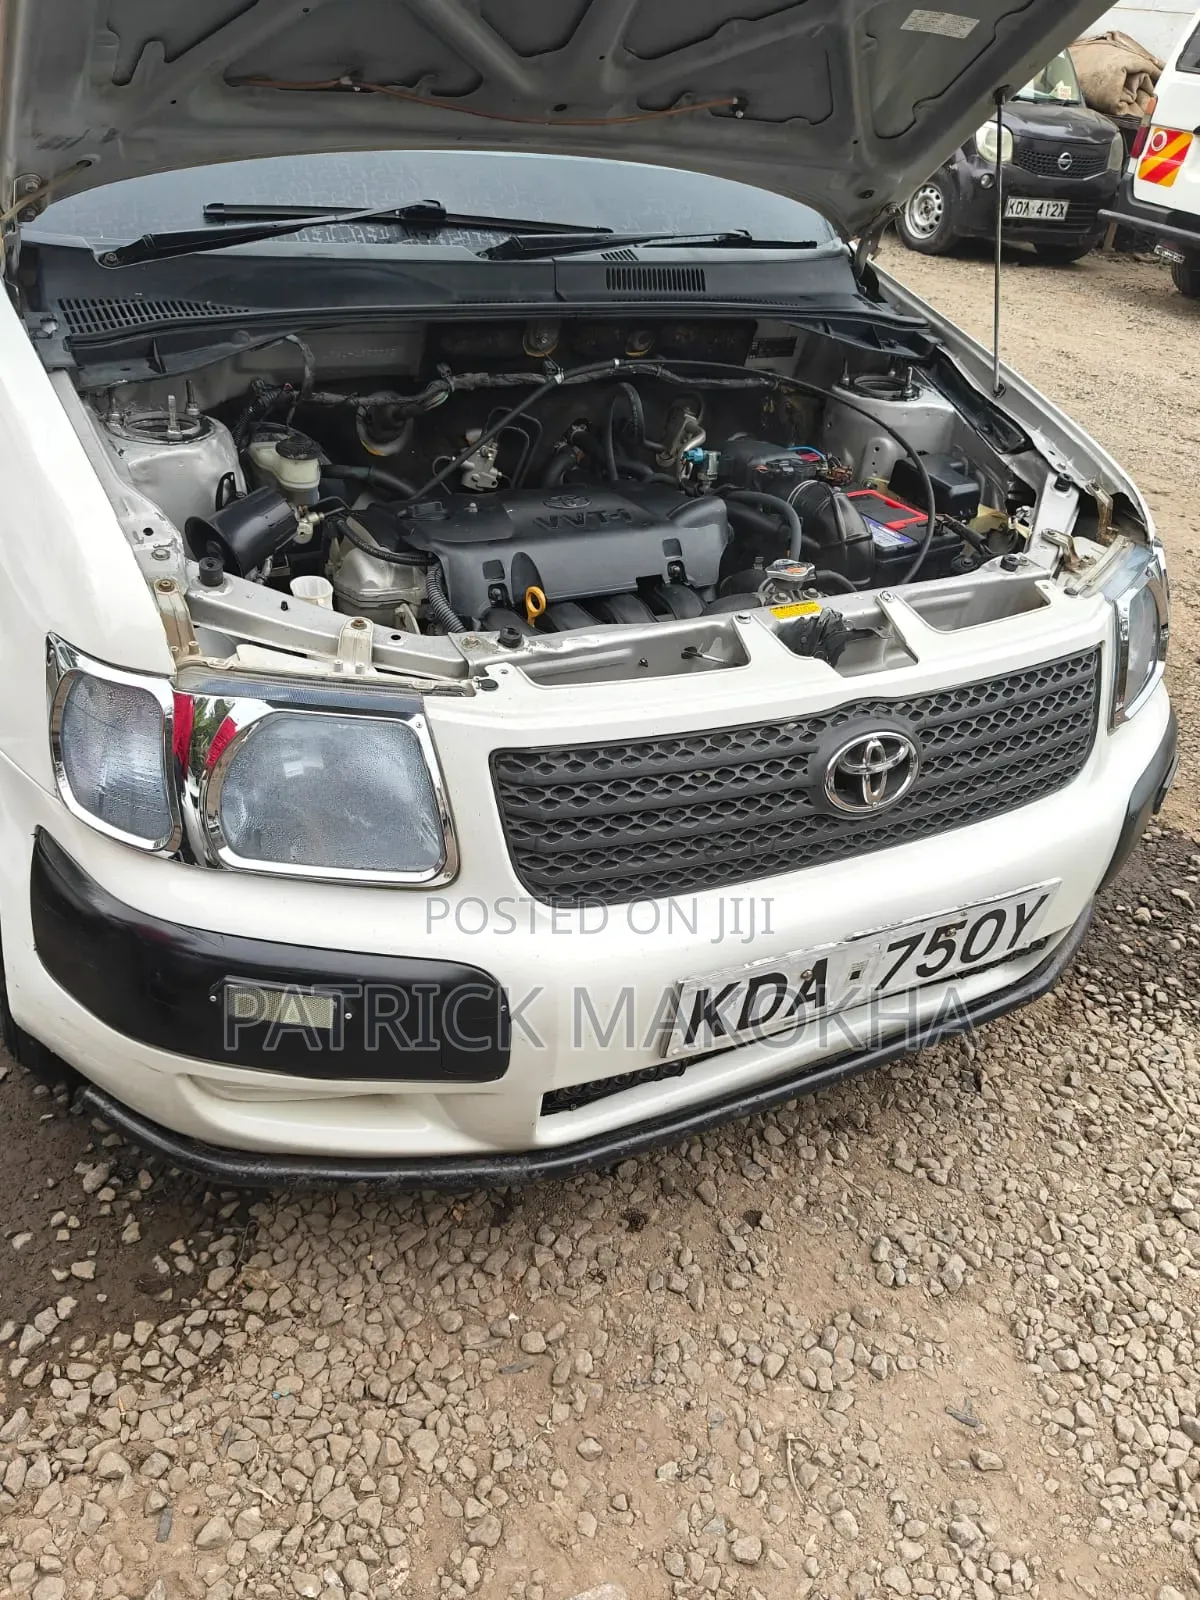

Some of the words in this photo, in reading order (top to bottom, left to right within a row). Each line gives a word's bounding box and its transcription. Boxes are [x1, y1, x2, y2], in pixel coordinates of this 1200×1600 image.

[1035, 202, 1065, 217] 412X
[684, 957, 829, 1046] KDA
[875, 893, 1050, 991] 750Y
